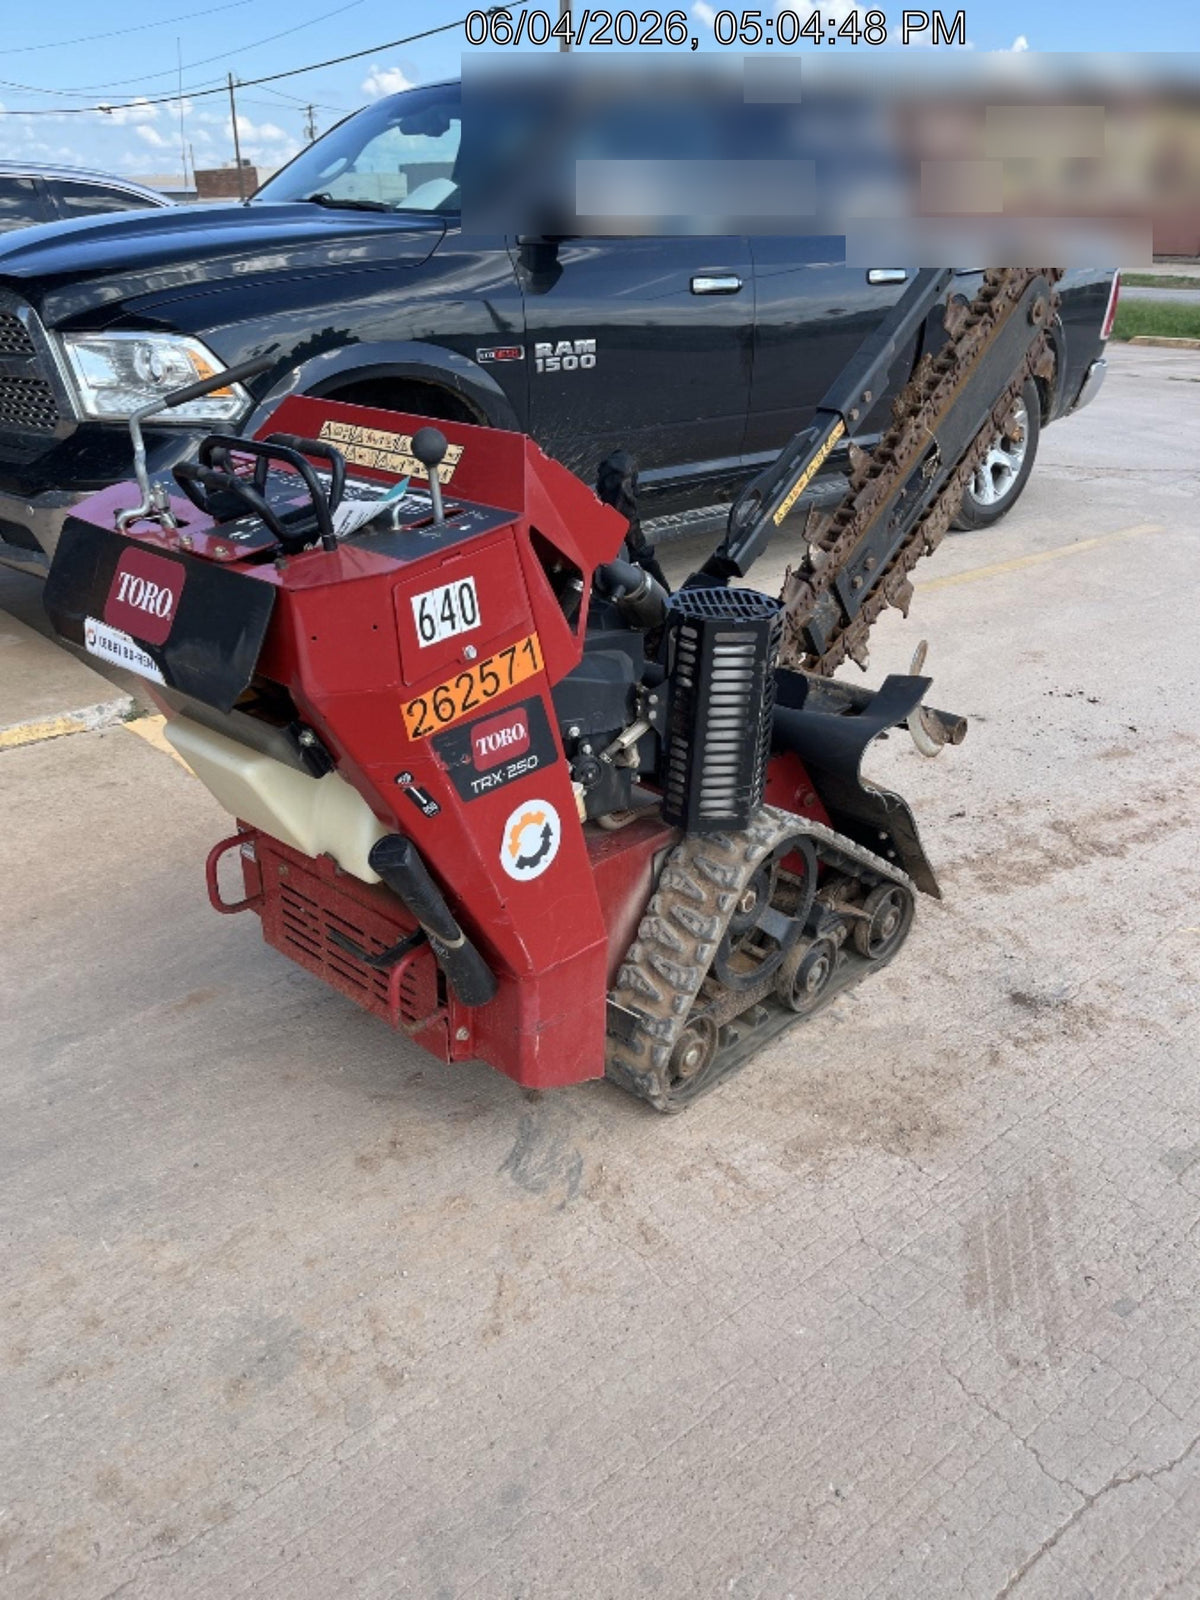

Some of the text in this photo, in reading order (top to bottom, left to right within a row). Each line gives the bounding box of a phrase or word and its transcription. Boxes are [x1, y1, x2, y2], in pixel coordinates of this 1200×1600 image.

[535, 339, 596, 358] RAM
[536, 354, 596, 374] 1500
[116, 571, 173, 618] TORO
[419, 582, 477, 641] 640
[406, 637, 538, 739] 262571
[475, 722, 525, 757] TORO
